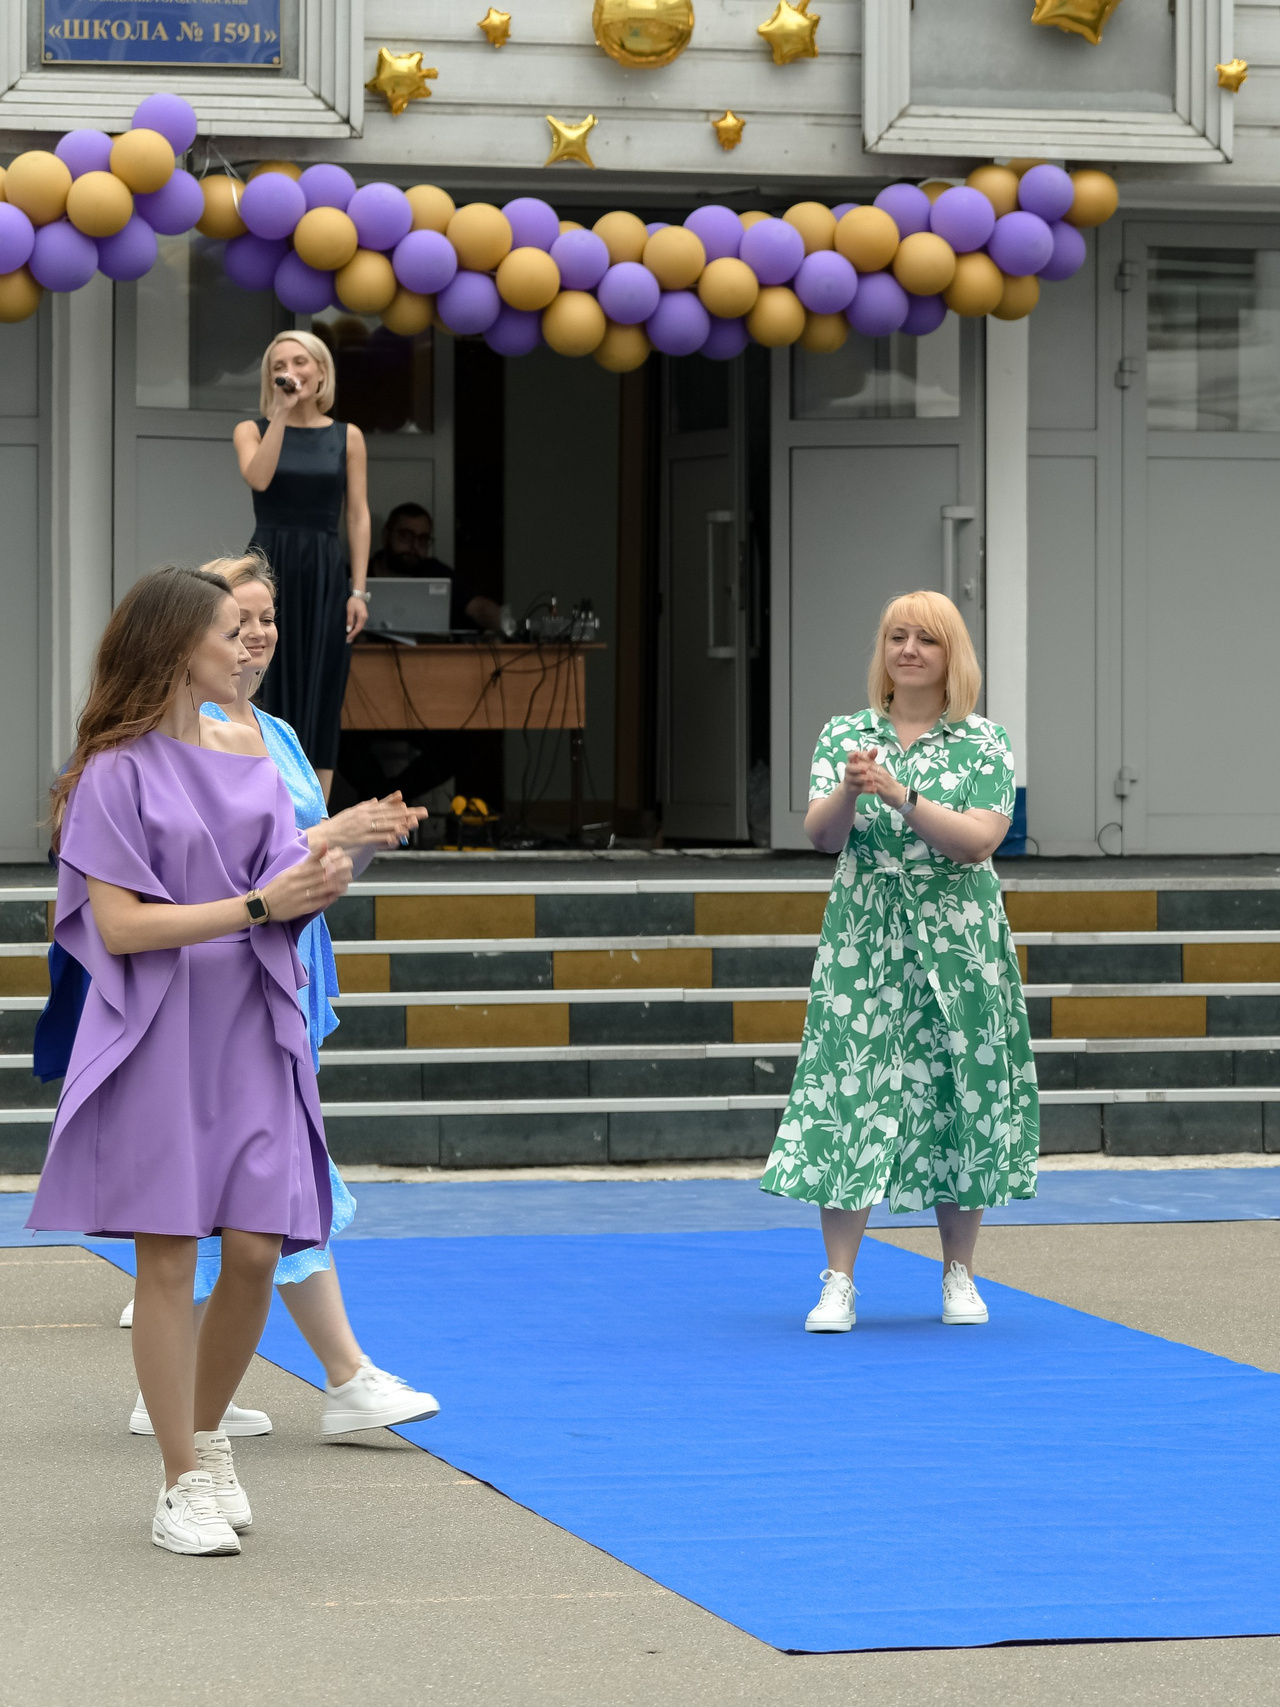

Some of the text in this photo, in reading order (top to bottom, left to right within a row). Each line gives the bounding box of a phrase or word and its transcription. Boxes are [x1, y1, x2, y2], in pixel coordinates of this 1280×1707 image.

[48, 19, 277, 44] «ШКОЛА № 1591»
